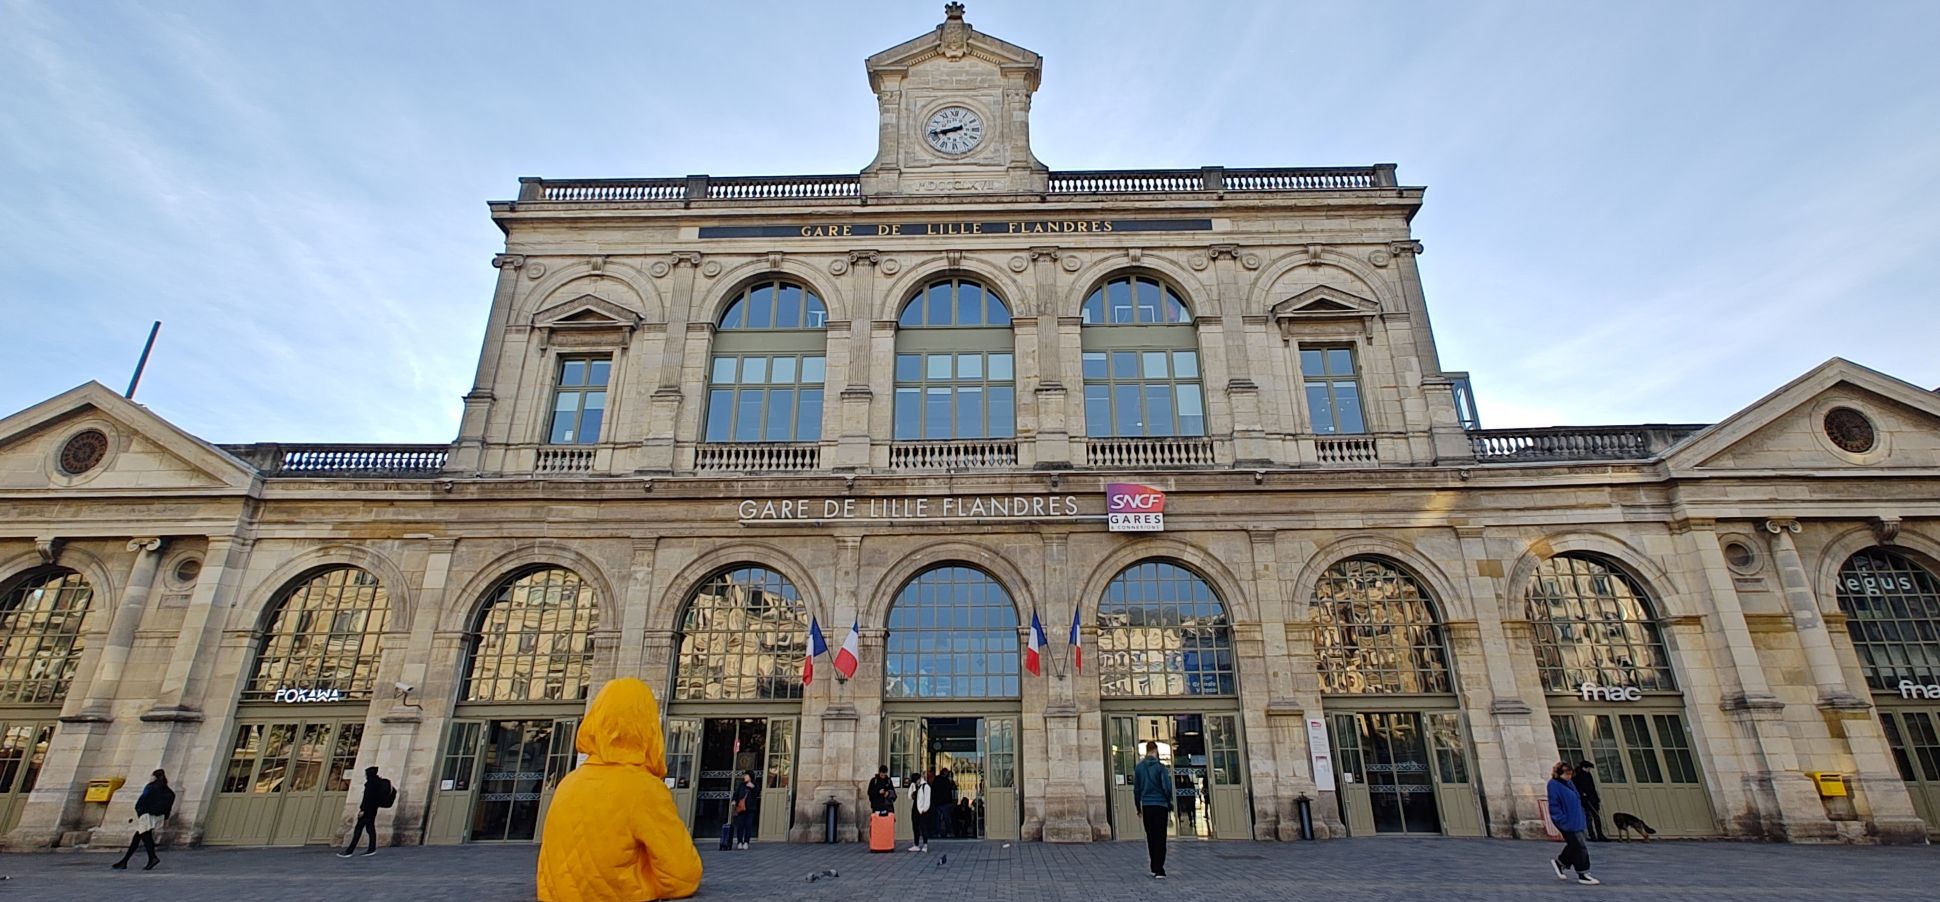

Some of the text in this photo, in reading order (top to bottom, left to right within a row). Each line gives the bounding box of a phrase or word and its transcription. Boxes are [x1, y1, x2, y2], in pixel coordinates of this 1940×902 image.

[801, 221, 1113, 237] GARE DE LILLE FLANDRES
[738, 496, 1078, 519] GARE DE LILLE FLANDRES
[1111, 494, 1162, 509] SNCF
[1110, 514, 1161, 524] GARES
[274, 688, 339, 703] POKAWA
[1581, 682, 1642, 701] fnac
